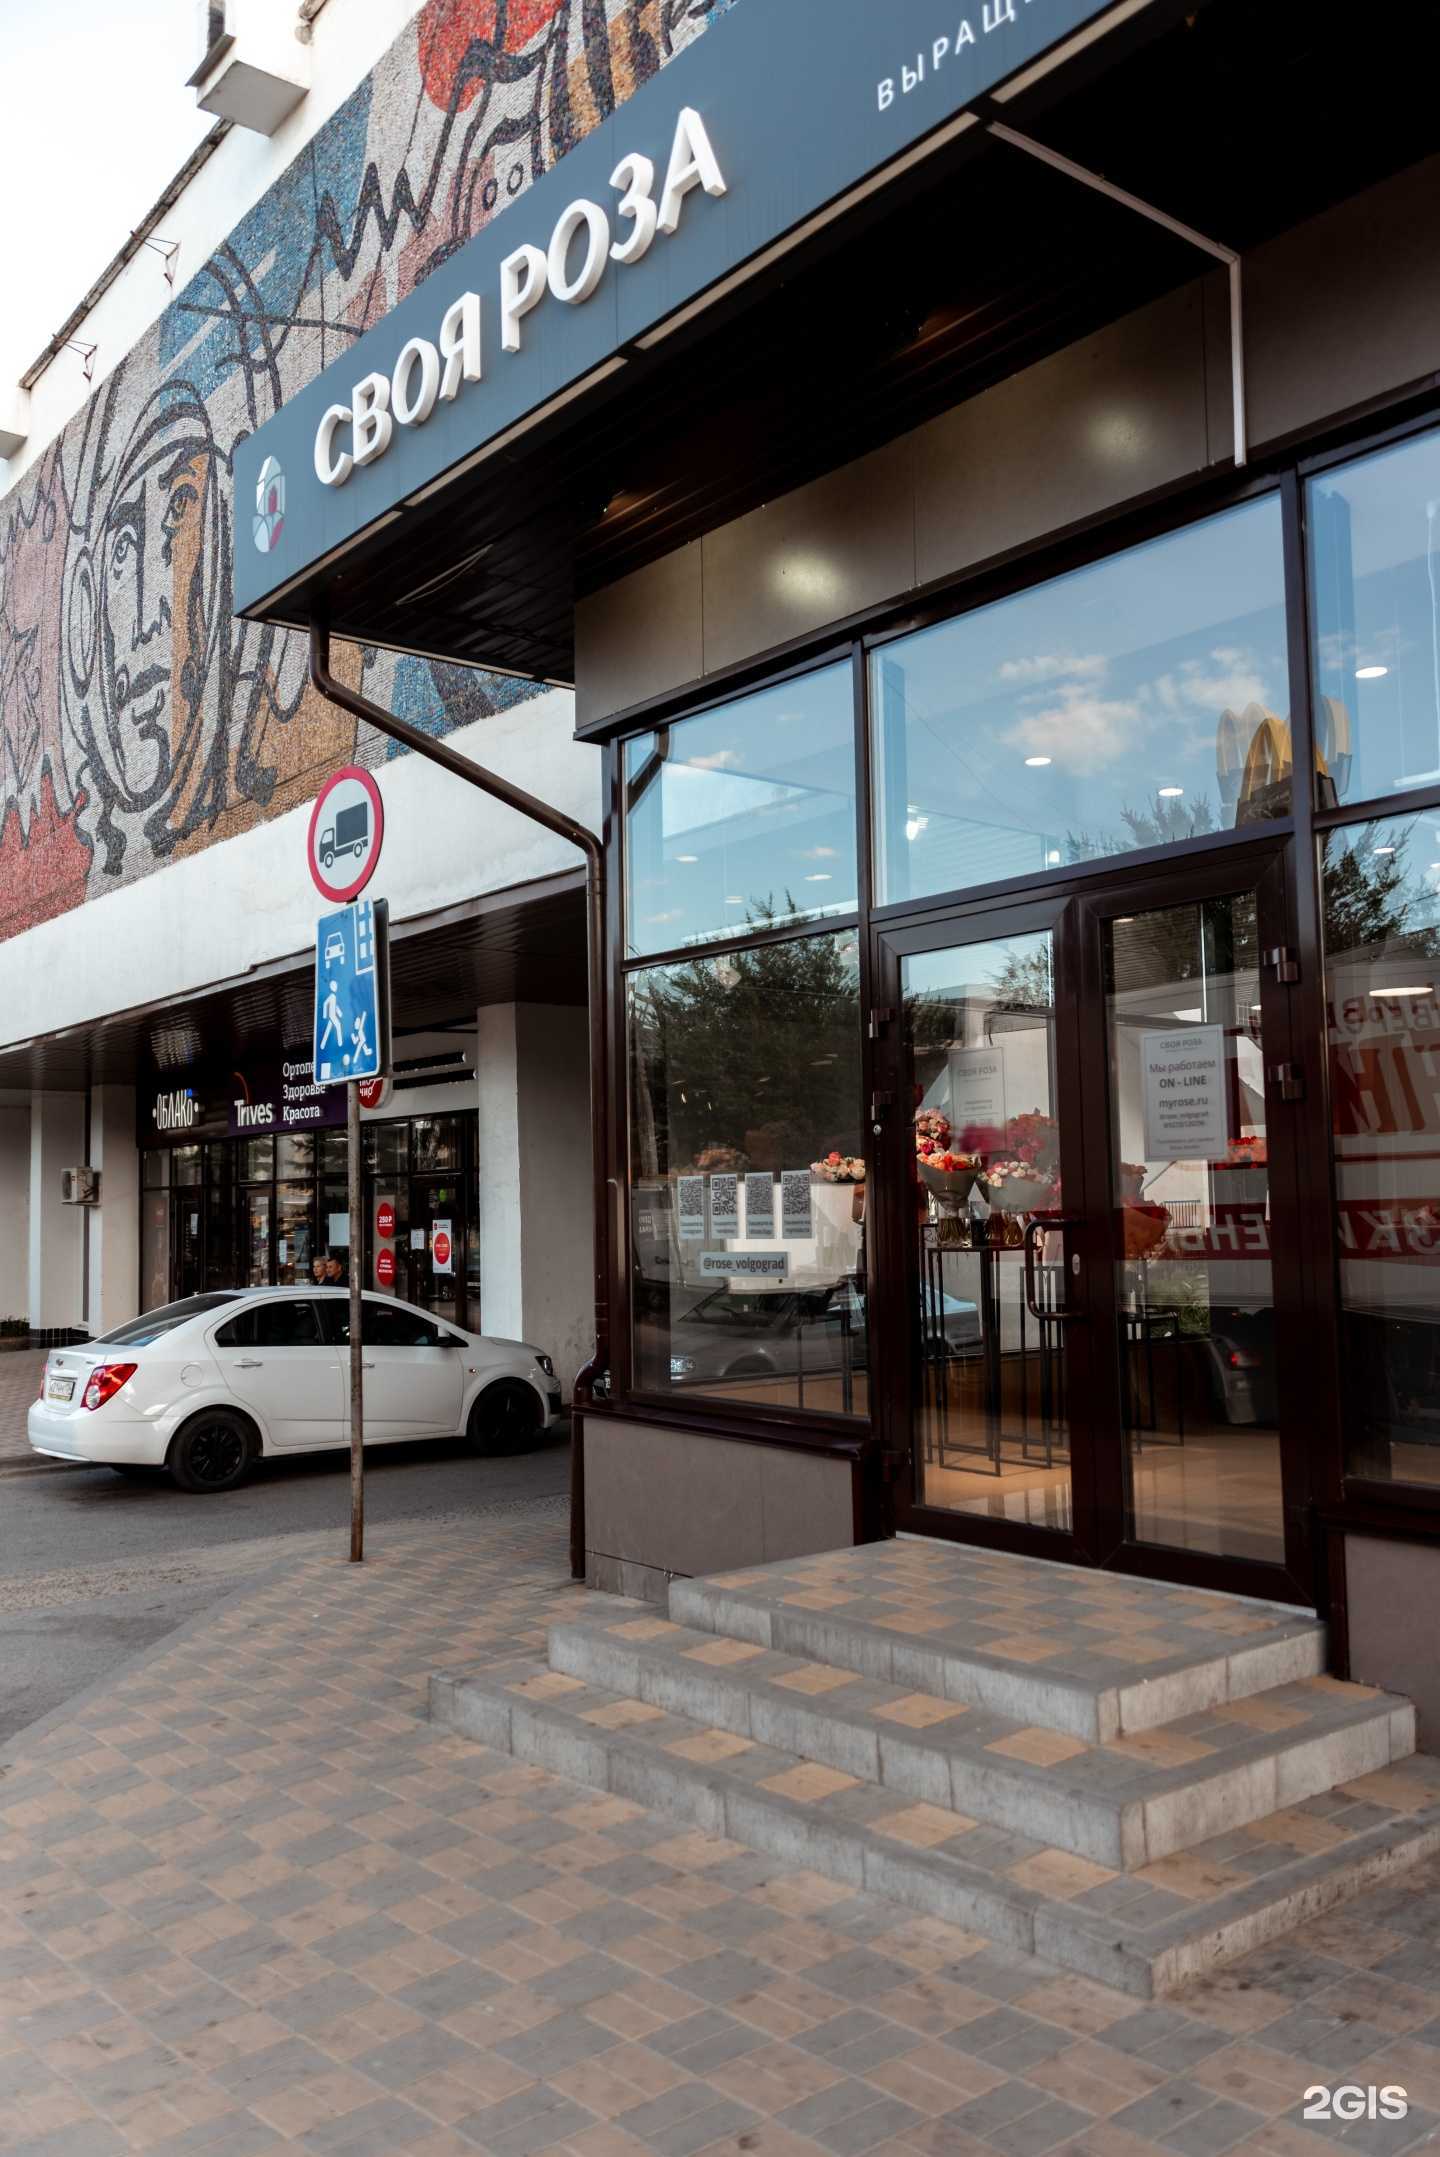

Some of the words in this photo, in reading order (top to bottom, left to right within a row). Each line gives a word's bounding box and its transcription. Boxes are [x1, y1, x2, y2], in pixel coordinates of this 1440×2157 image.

[876, 0, 1033, 112] ВЫРАЩ
[313, 290, 482, 488] СВОЯ
[499, 106, 728, 354] РОЗА
[282, 1062, 315, 1080] Ортопе
[1149, 1063, 1167, 1073] Мы
[1168, 1058, 1217, 1074] работаем
[1159, 1078, 1176, 1089] ON
[1183, 1074, 1207, 1087] LINE
[282, 1083, 326, 1101] Здоровье
[1159, 1095, 1209, 1110] myrose.ru
[233, 1098, 274, 1128] Trives
[282, 1105, 321, 1125] Красота
[703, 1256, 785, 1273] @rose_volgograd
